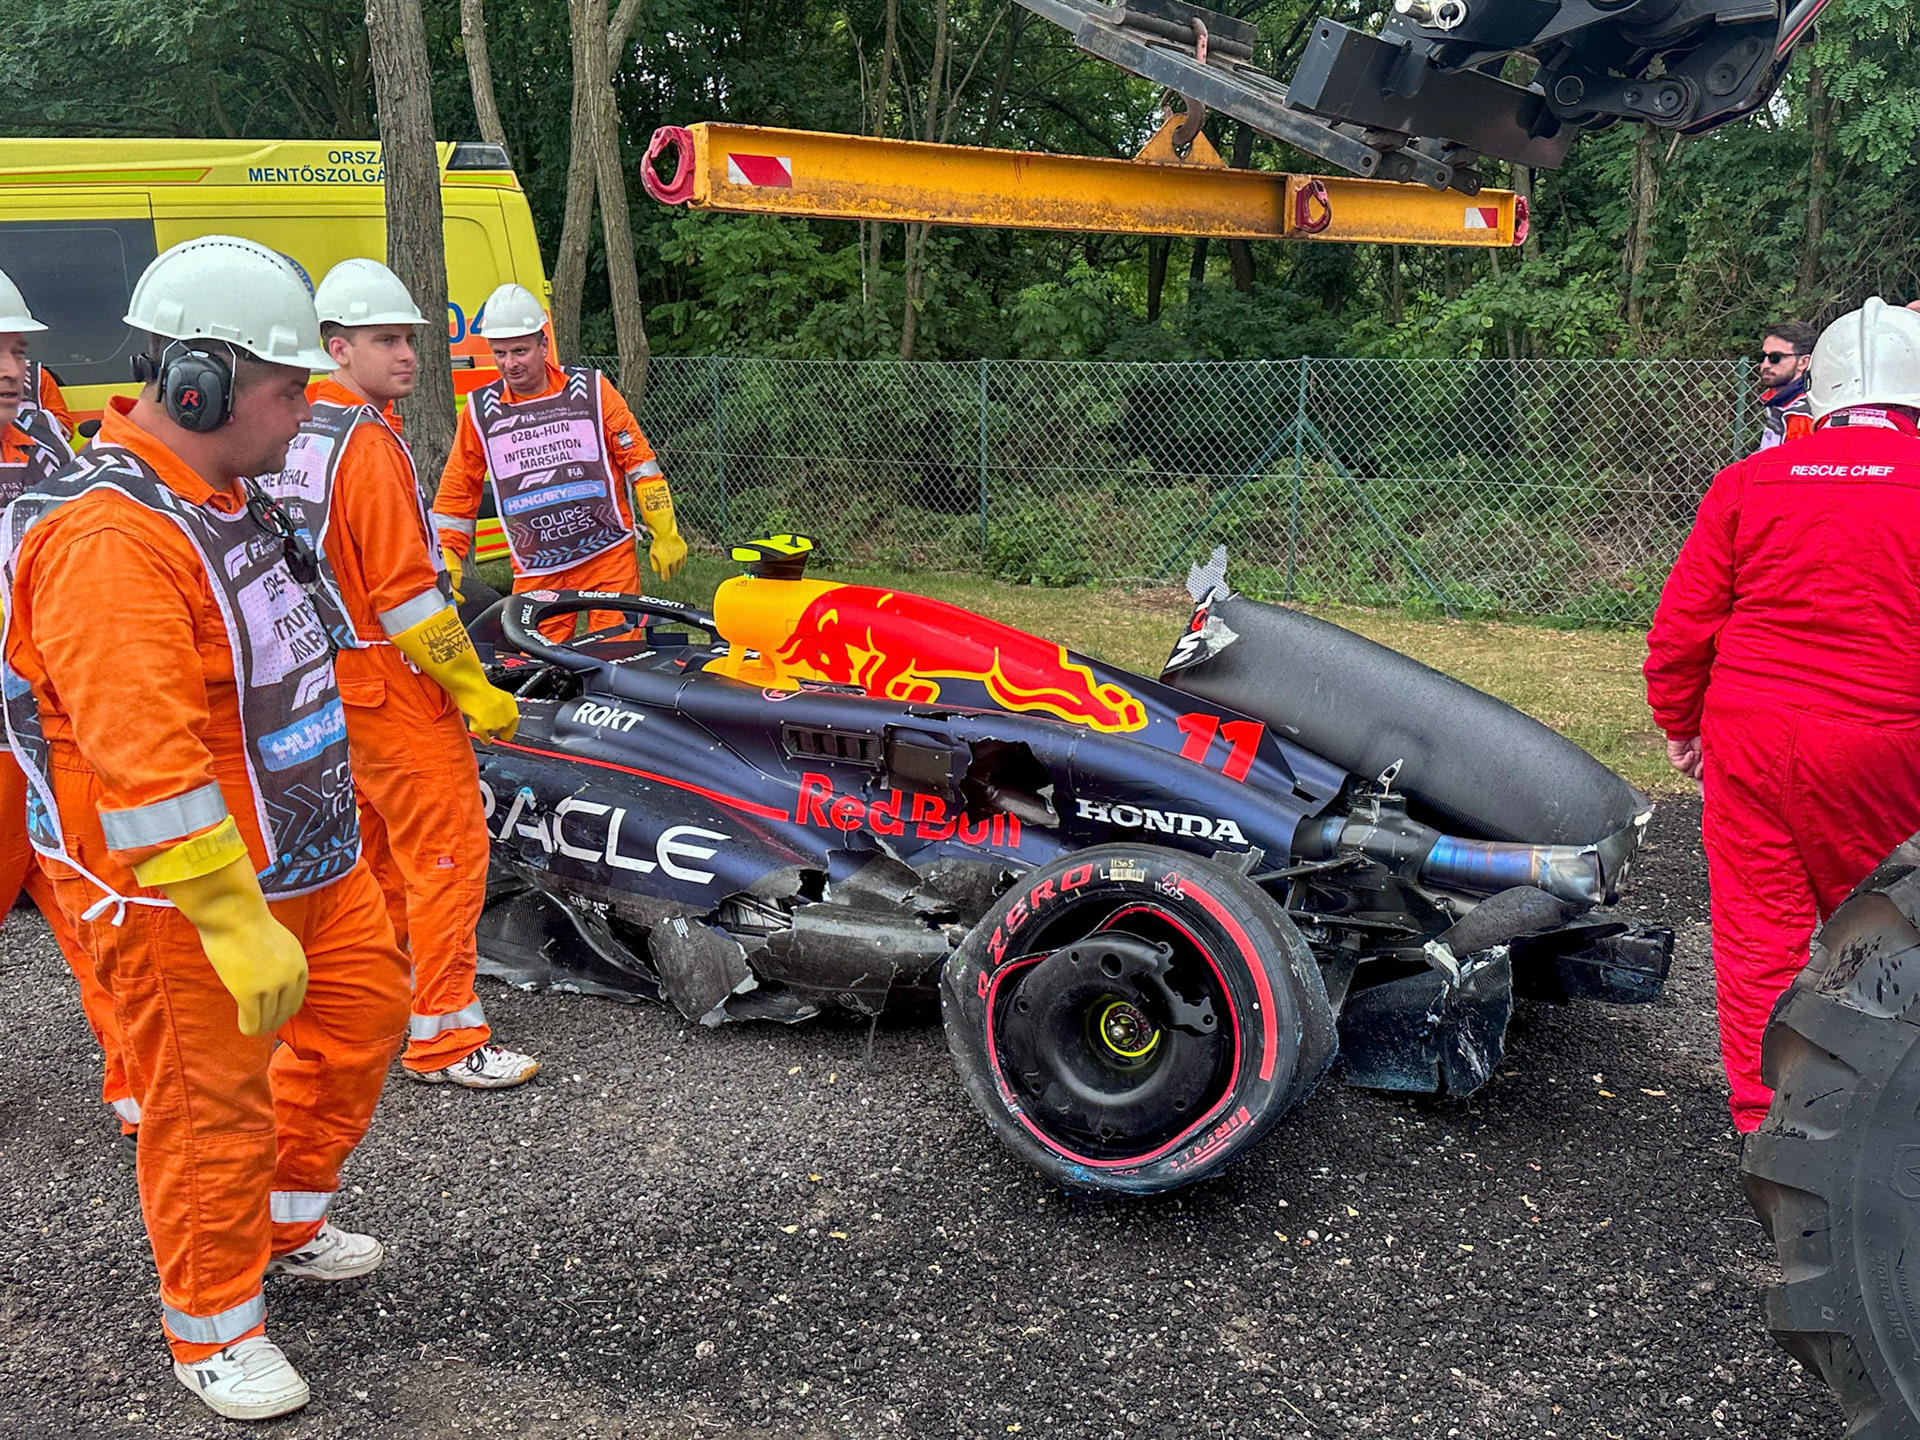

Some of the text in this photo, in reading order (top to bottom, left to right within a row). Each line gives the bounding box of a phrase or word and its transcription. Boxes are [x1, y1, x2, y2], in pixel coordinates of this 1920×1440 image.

[248, 165, 385, 182] MENTŐSZOLGÁ
[504, 438, 581, 463] INTERVENTION
[520, 451, 573, 471] MARSHAL
[567, 466, 584, 478] FIA
[1790, 464, 1896, 477] RESCUE CHIEF
[530, 505, 591, 530] COURSE
[540, 515, 597, 542] ACCESS
[577, 590, 685, 609] telcel zoom
[571, 700, 644, 733] ROKT
[1175, 711, 1265, 783] 11
[795, 771, 1021, 848] Red Bull
[1075, 798, 1249, 846] HONDA
[479, 778, 733, 885] RACLE
[987, 862, 1094, 965] ZERO
